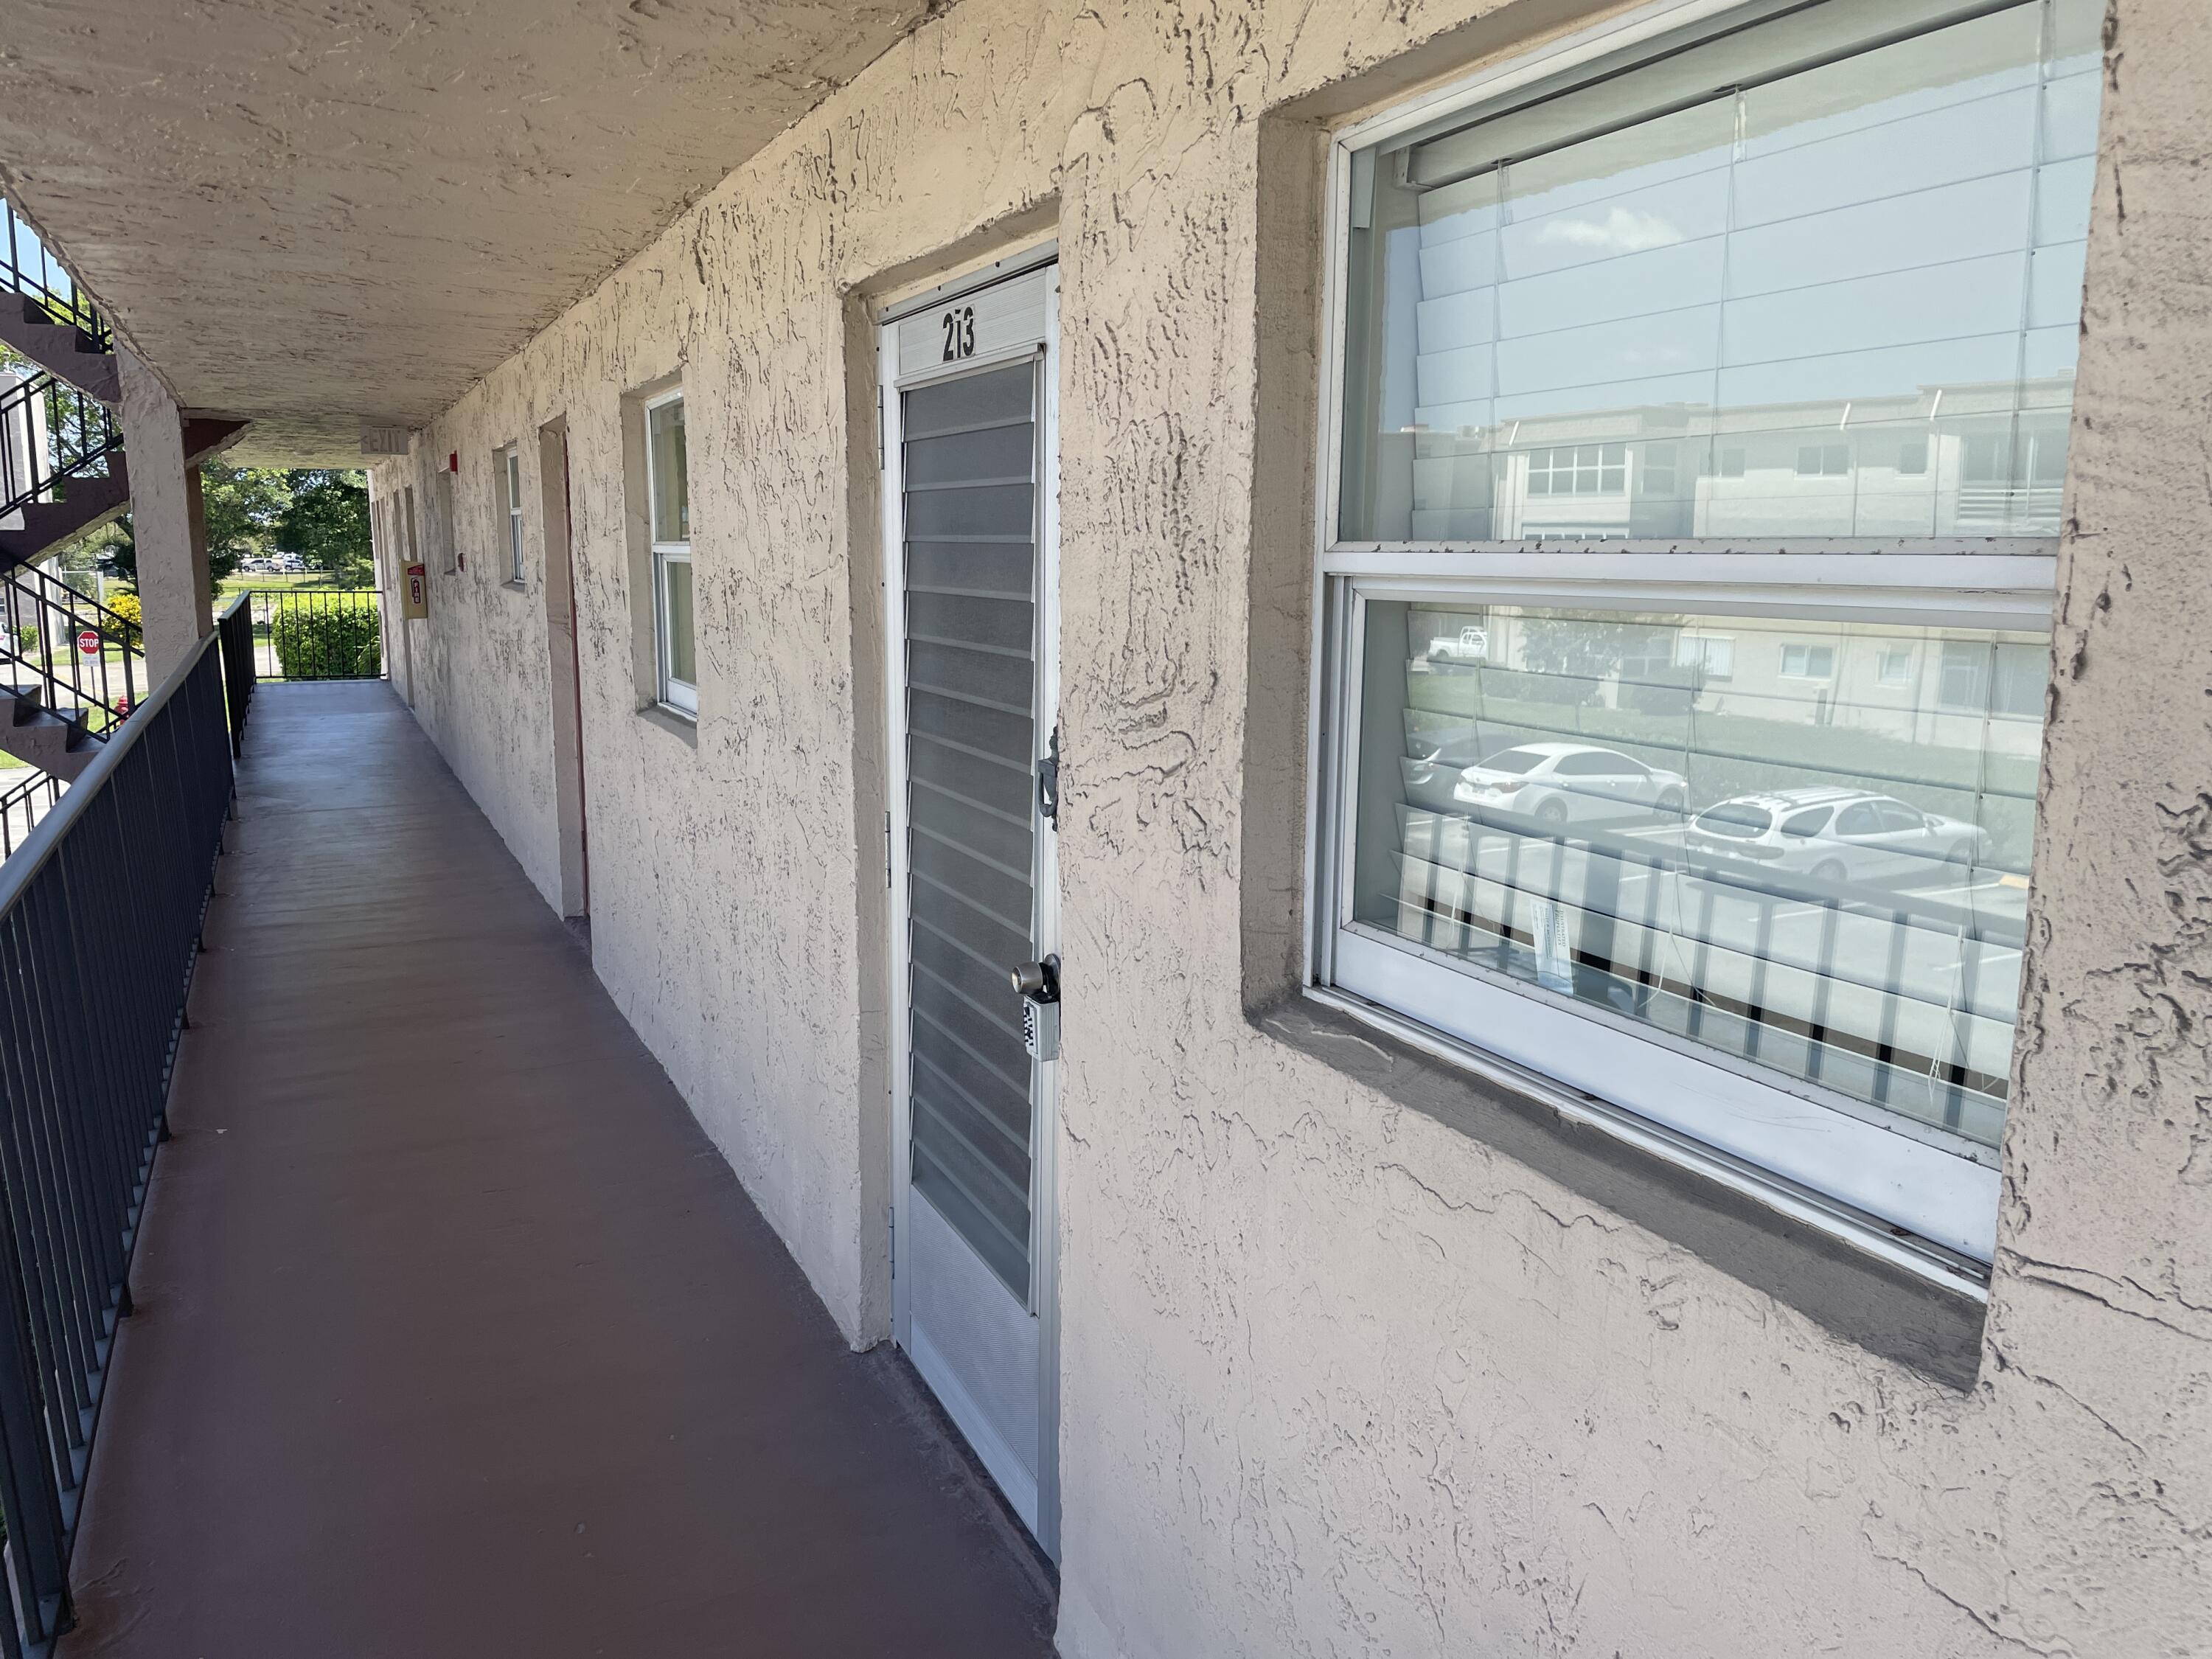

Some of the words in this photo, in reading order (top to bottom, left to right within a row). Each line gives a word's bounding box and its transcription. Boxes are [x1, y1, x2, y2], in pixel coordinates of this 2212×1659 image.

[943, 307, 974, 361] 213
[369, 428, 400, 452] EXIT
[80, 639, 99, 647] STOP
